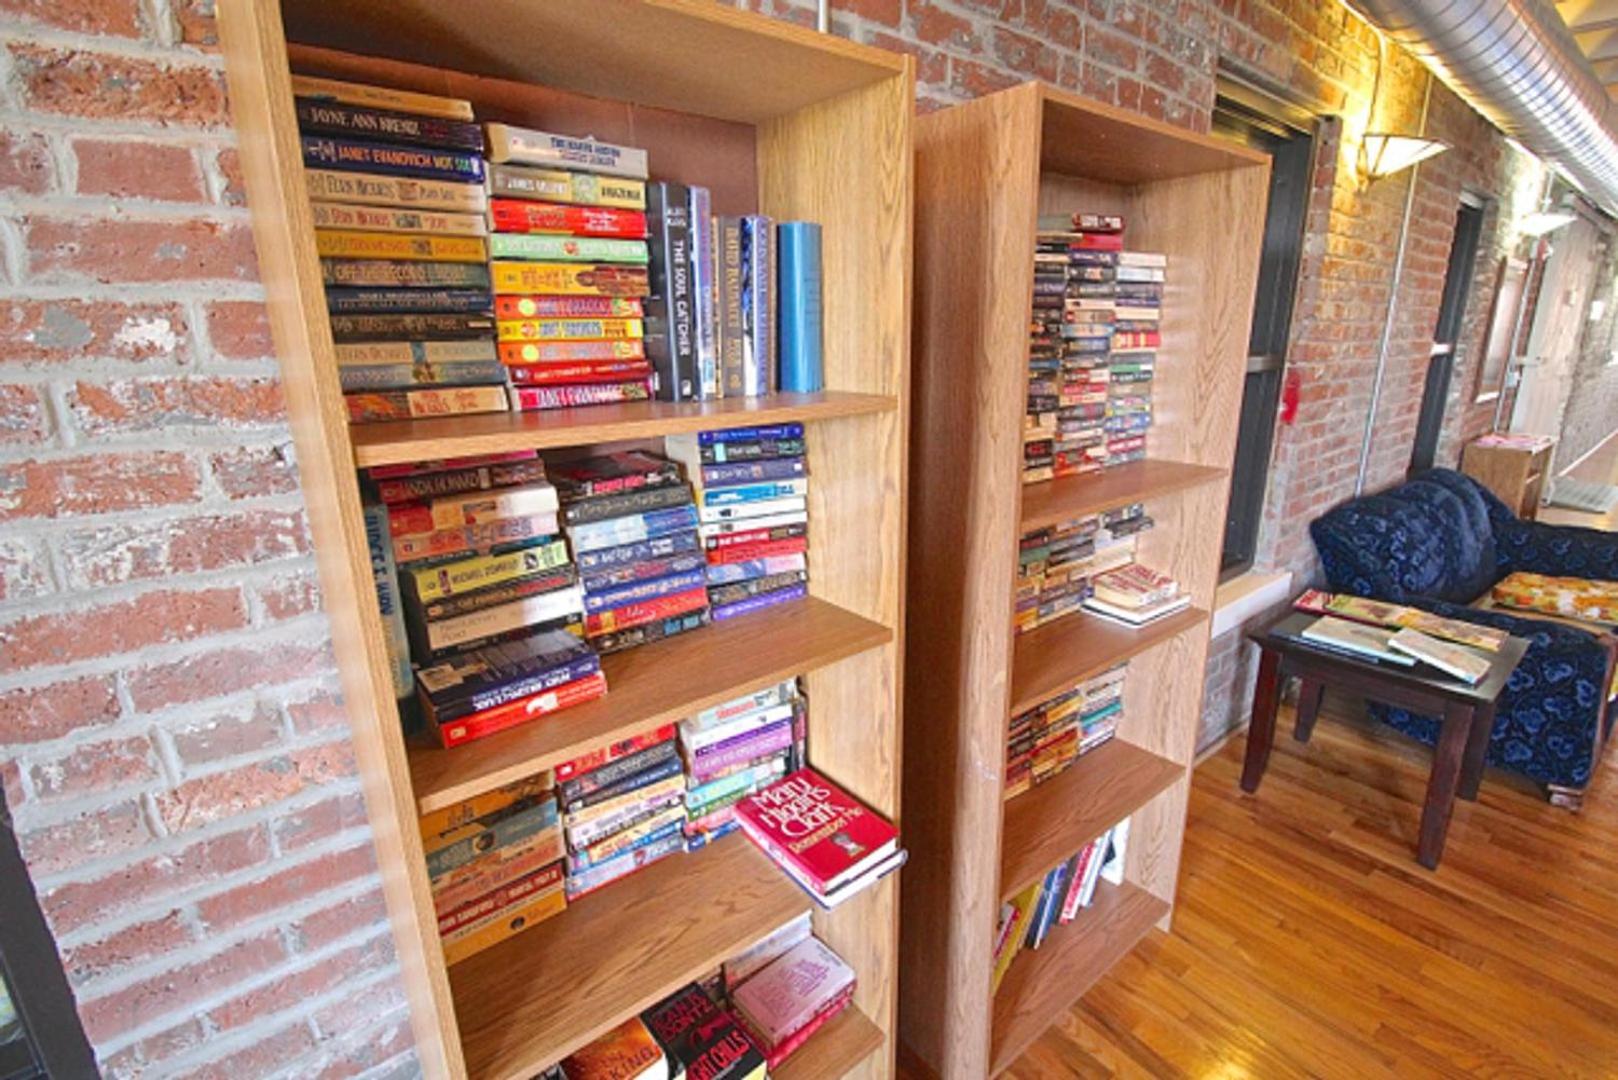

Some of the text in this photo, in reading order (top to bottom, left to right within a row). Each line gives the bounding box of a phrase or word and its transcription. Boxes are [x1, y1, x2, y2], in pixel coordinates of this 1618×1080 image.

[673, 240, 692, 356] THE SOUL CATCHER
[751, 776, 812, 812] Mary
[759, 786, 831, 829] Higgins
[781, 802, 846, 836] Clark
